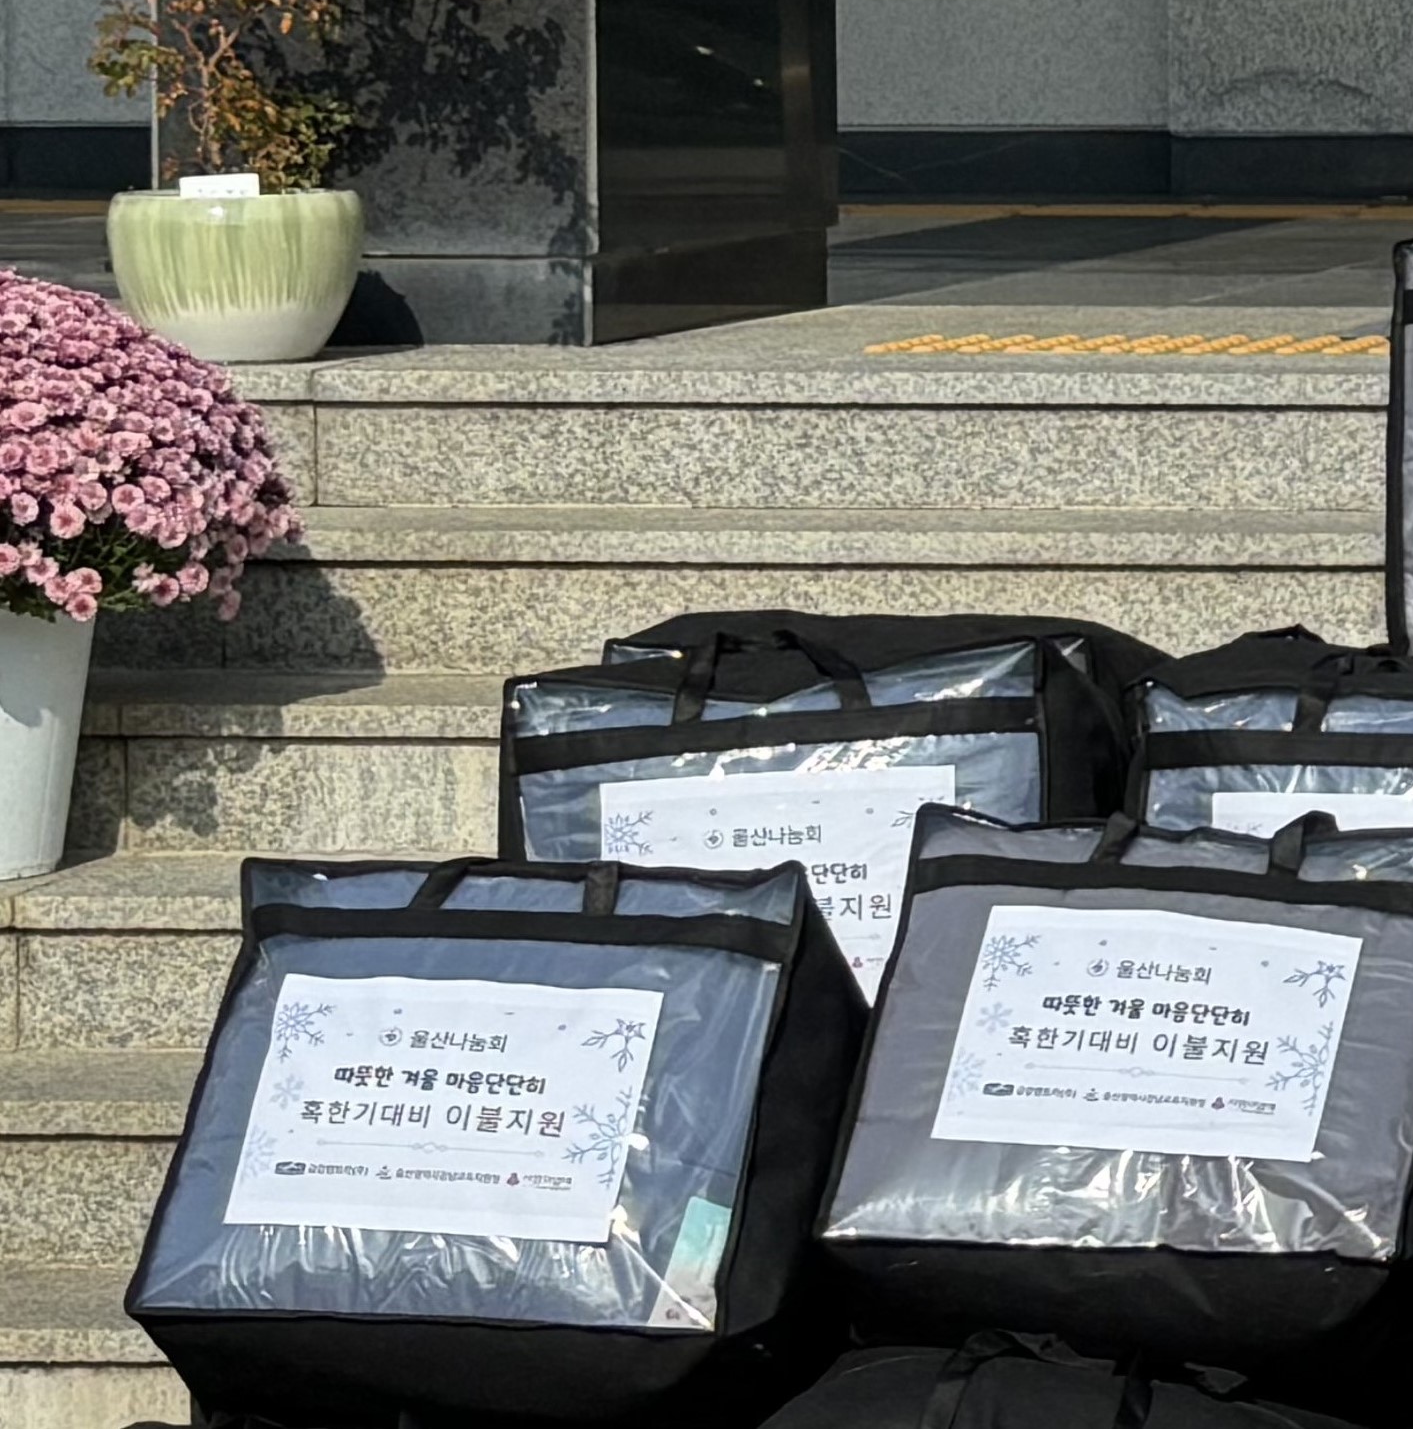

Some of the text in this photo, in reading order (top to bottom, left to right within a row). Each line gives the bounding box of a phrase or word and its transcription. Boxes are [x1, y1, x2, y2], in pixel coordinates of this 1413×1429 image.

[732, 825, 822, 848] 울산나눔회
[811, 863, 868, 885] 단단히
[817, 893, 892, 921] 불지원
[1116, 961, 1211, 985] 울산나눔회
[1043, 995, 1250, 1027] 따뜻한 겨울 마음단단히
[410, 1030, 507, 1053] 울산나눔회
[1009, 1025, 1269, 1065] 혹한기대비 이불지원
[334, 1066, 546, 1095] 따뜻한 겨울 마음단단히
[301, 1100, 565, 1137] 혹한기대비 이불지원
